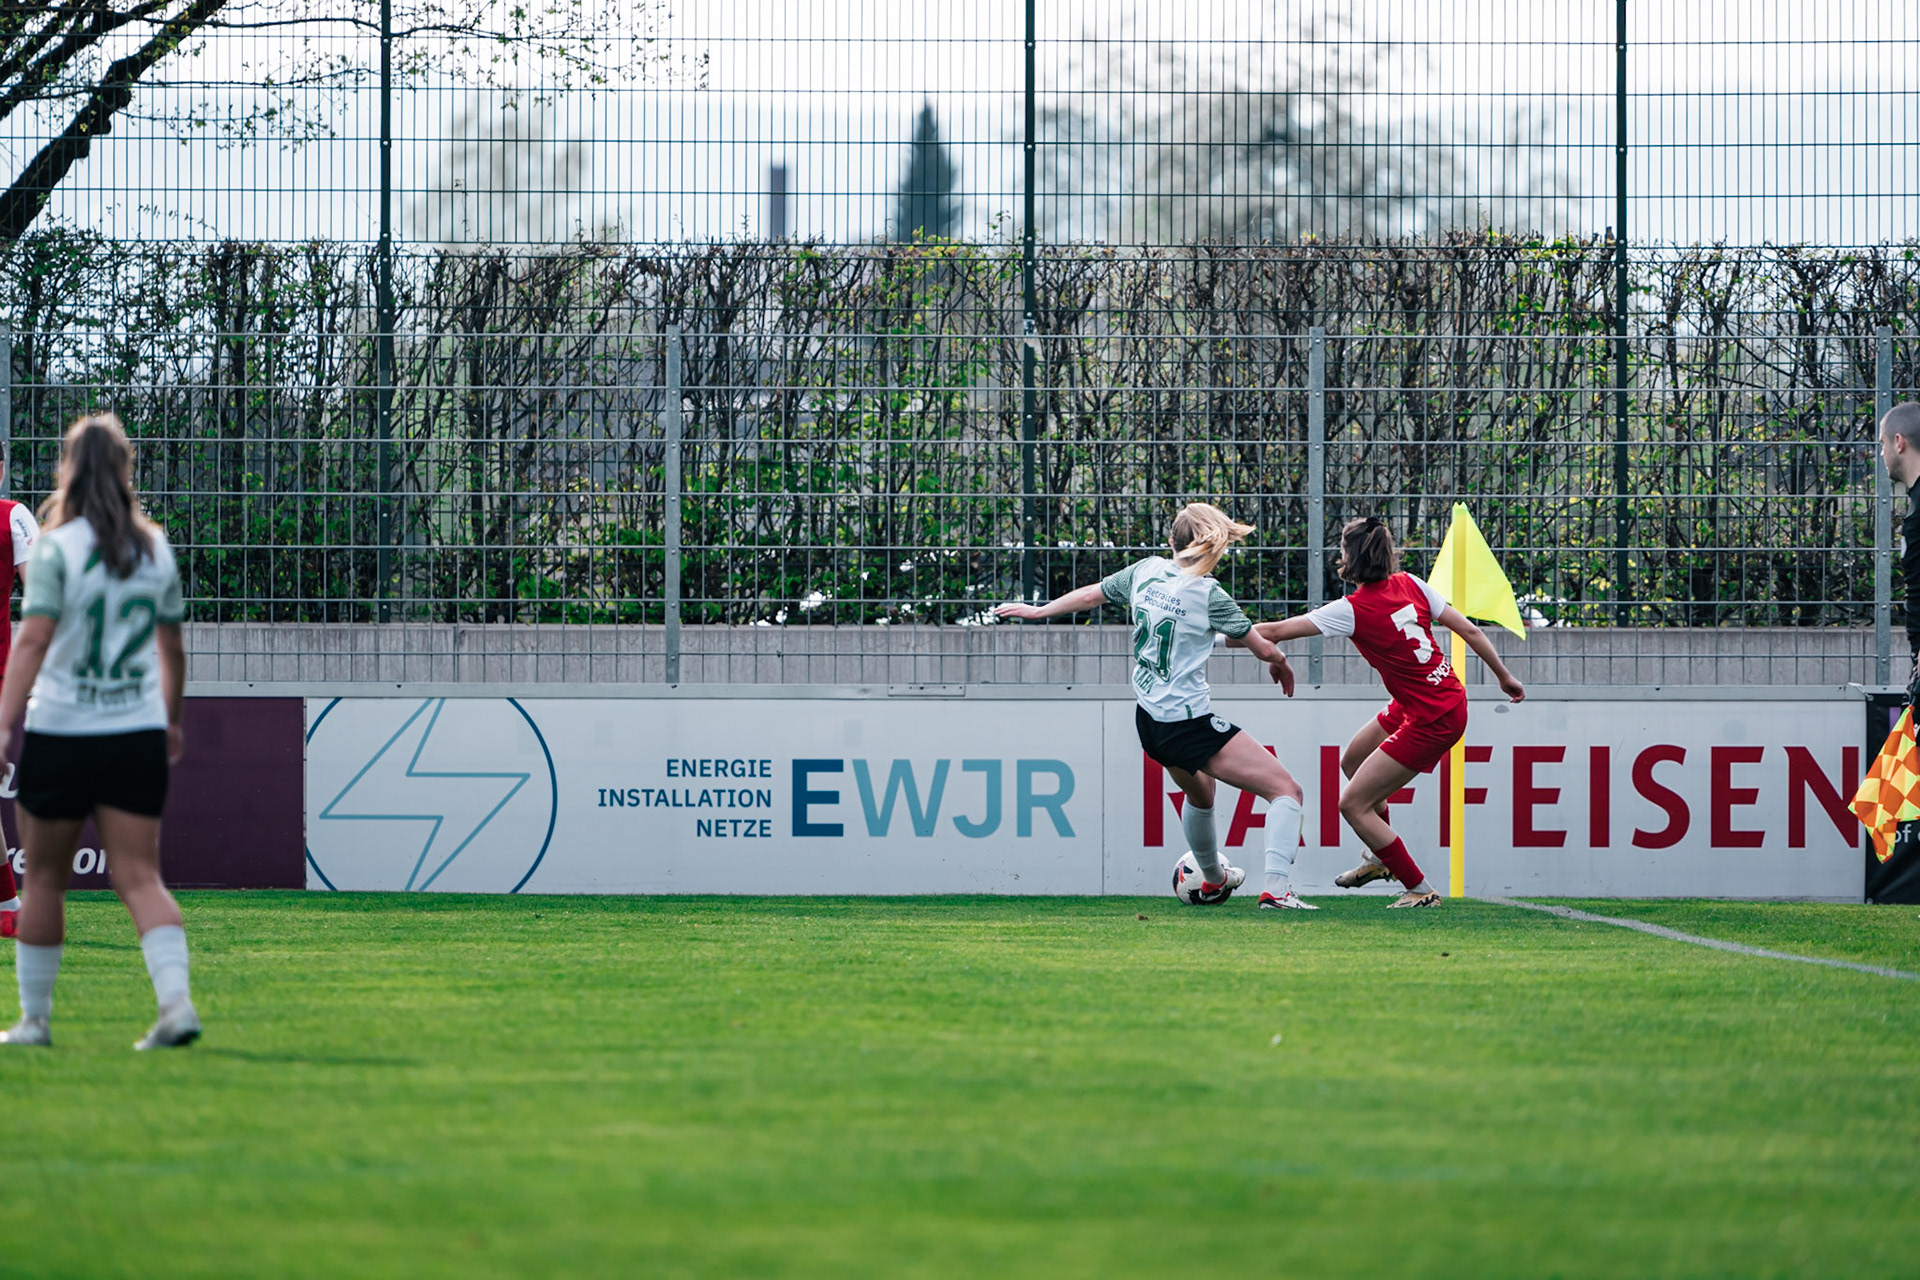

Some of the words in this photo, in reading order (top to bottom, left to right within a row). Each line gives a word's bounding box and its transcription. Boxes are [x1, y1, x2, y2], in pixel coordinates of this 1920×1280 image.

[1144, 595, 1187, 617] Populaires
[1145, 587, 1182, 606] Retraites
[73, 592, 157, 680] 12
[1133, 606, 1176, 682] 21
[1390, 603, 1434, 664] 3
[666, 759, 772, 778] ENERGIE
[598, 788, 772, 808] INSTALLATION
[792, 759, 1077, 838] EWJR
[1143, 744, 1859, 849] RIFEISEN
[696, 819, 772, 837] NETZE
